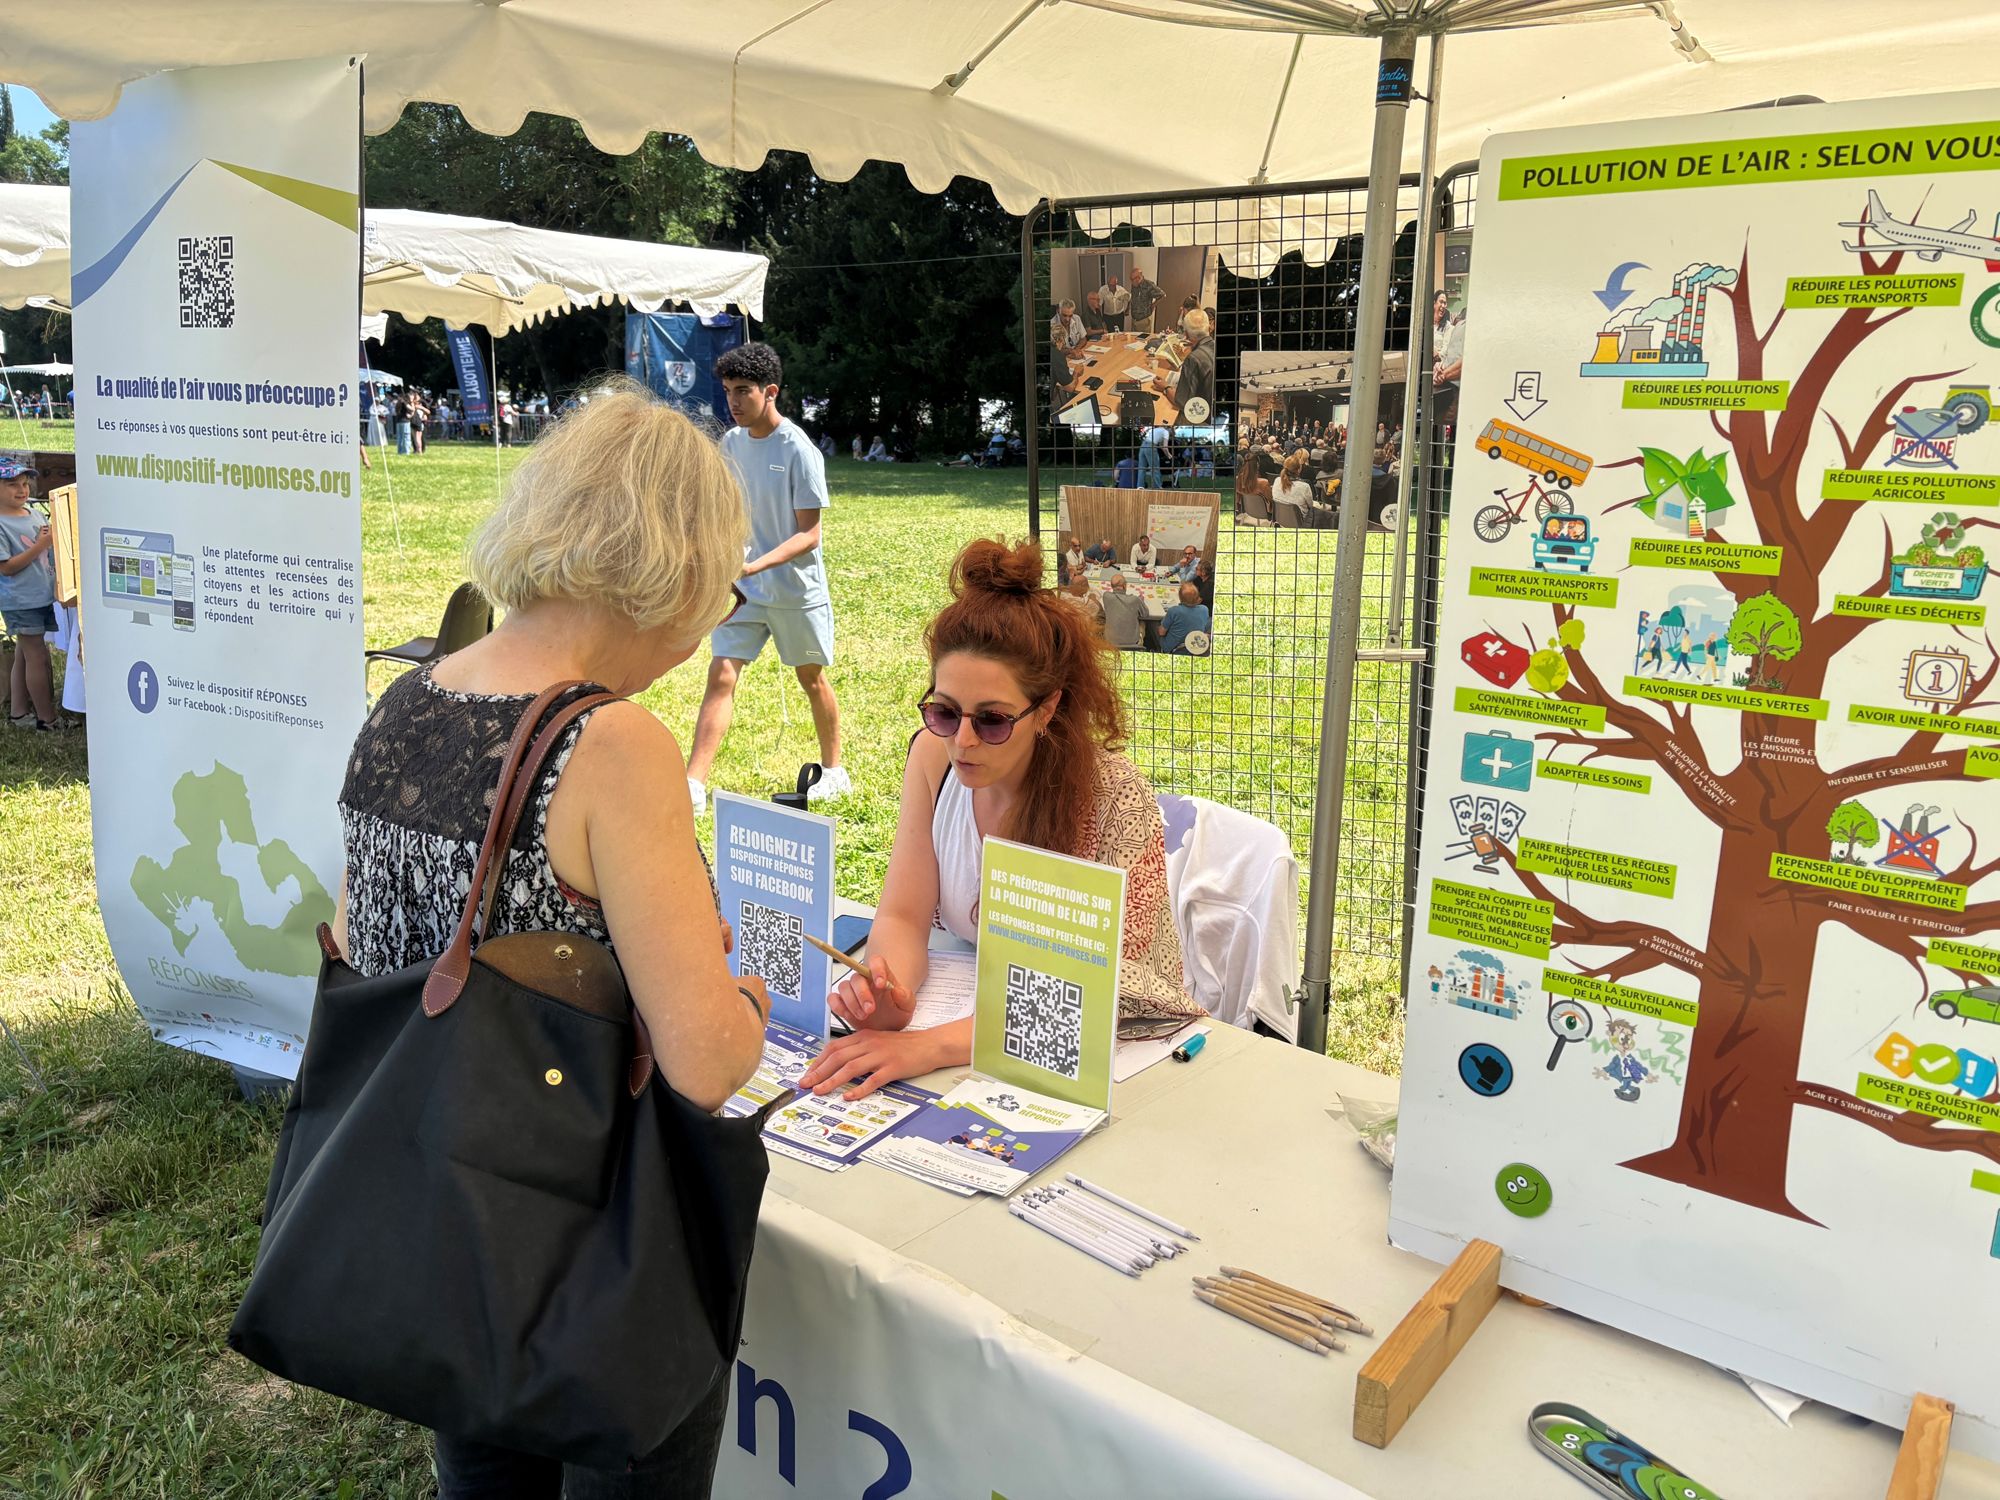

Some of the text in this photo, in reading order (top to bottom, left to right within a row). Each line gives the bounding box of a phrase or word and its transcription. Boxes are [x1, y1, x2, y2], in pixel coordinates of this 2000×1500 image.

[1523, 158, 1667, 188] POLLUTION
[1677, 155, 1712, 177] DE
[1816, 140, 1914, 168] SELON
[1792, 278, 1957, 291] RÉDUIRE LES POLLUTIONS
[1815, 293, 1927, 304] DES TRANSPORTS
[96, 376, 335, 408] La qualité de l'air vous préoccupe
[1632, 382, 1779, 394] RÉDUIRE LES POLLUTIONS
[1659, 397, 1746, 406] INDUSTRIELLES
[98, 418, 342, 444] Les réponses vos questions sont peut-être ici
[96, 454, 350, 498] www.dispositif-reponses.org
[1830, 471, 1996, 489] RÉDUIRE LES POLLUTIONS
[1872, 488, 1945, 500] AGRICOLES
[202, 546, 354, 571] Une plateforme qui centralise
[1634, 541, 1778, 560] RÉDUIRE LES POLLUTIONS
[1666, 555, 1740, 569] DES MAISONS
[203, 561, 216, 574] les
[225, 564, 265, 579] attentes
[276, 570, 328, 585] recensées
[337, 576, 354, 588] des
[1479, 572, 1609, 591] INCITER AUX TRANSPORTS
[1920, 579, 1949, 587] VERTS
[203, 579, 354, 605] citoyens et les actions des
[1495, 585, 1589, 601] MOINS POLLUANTS
[204, 596, 341, 620] acteurs du territoire qui
[204, 610, 254, 625] répondent
[1837, 598, 1981, 621] RÉDUIRE LES DÉCHETS
[167, 676, 307, 707] Suivez le dispositif RÉPONSES
[1640, 683, 1810, 713] FAVORISER DES VILLES VERTES
[168, 696, 324, 729] sur Facebook DispositifReponses
[1469, 702, 1588, 727] SANTÉ/ENVIRONNEMENT
[1856, 710, 1895, 723] AVOIR
[1900, 715, 1925, 726] UNE
[1929, 718, 1961, 731] INFO
[1760, 743, 1805, 755] ÉMISSIONS
[1764, 735, 1800, 745] RÉDUIRE
[1761, 752, 1815, 765] POLLUTIONS
[1544, 765, 1642, 789] ADAPTER LES SOINS
[1828, 760, 1949, 787] INFORMER SENSIBILISER
[730, 824, 814, 865] REJOIGNEZ LE
[1525, 840, 1553, 852] FAIRE
[1554, 845, 1609, 863] RESPECTER
[1611, 854, 1629, 866] LES
[730, 847, 813, 881] DISPOSITIF RÉPONSES
[1536, 852, 1671, 885] APPLIQUER LES SANCTIONS
[1776, 856, 1963, 896] REPENSER DÉVELOPPEMENT
[730, 865, 813, 904] SUR FACEBOOK
[991, 869, 1111, 912] DES PRÉOCCUPATIONS SUR
[1553, 867, 1633, 889] AUX POLLUEURS
[1777, 868, 1958, 908] ÉCONOMIQUE TERRITOIRE
[990, 887, 1001, 901] LA
[1003, 890, 1055, 916] POLLUTION
[1057, 905, 1070, 921] DE
[1435, 884, 1550, 914] PRENDRE COMPTE LES
[989, 910, 1000, 922] LES
[1001, 913, 1035, 933] RÉPONSES
[1036, 924, 1055, 937] SONT
[1094, 941, 1105, 952] ICI
[1431, 903, 1551, 935] TERRITOIRE (NOMBREUSES
[1432, 913, 1532, 942] INDUSTRIES, MÉLANGE
[1828, 901, 1967, 935] FAIRE EVOLUER TERRITOIRE
[988, 923, 1107, 968] WWW.DISPOSITIF-REPONSES.ORG
[1652, 936, 1696, 958] SURVEILLER
[148, 956, 254, 999] RÉPONSES
[1545, 971, 1696, 1014] RENFORCER LA SURVEILLANCE
[1604, 995, 1662, 1016] POLLUTION
[1804, 1089, 1825, 1100] AGIR
[1867, 1078, 2000, 1118] POSER DES QUESTION
[1916, 1102, 1982, 1125] RÉPONDRE
